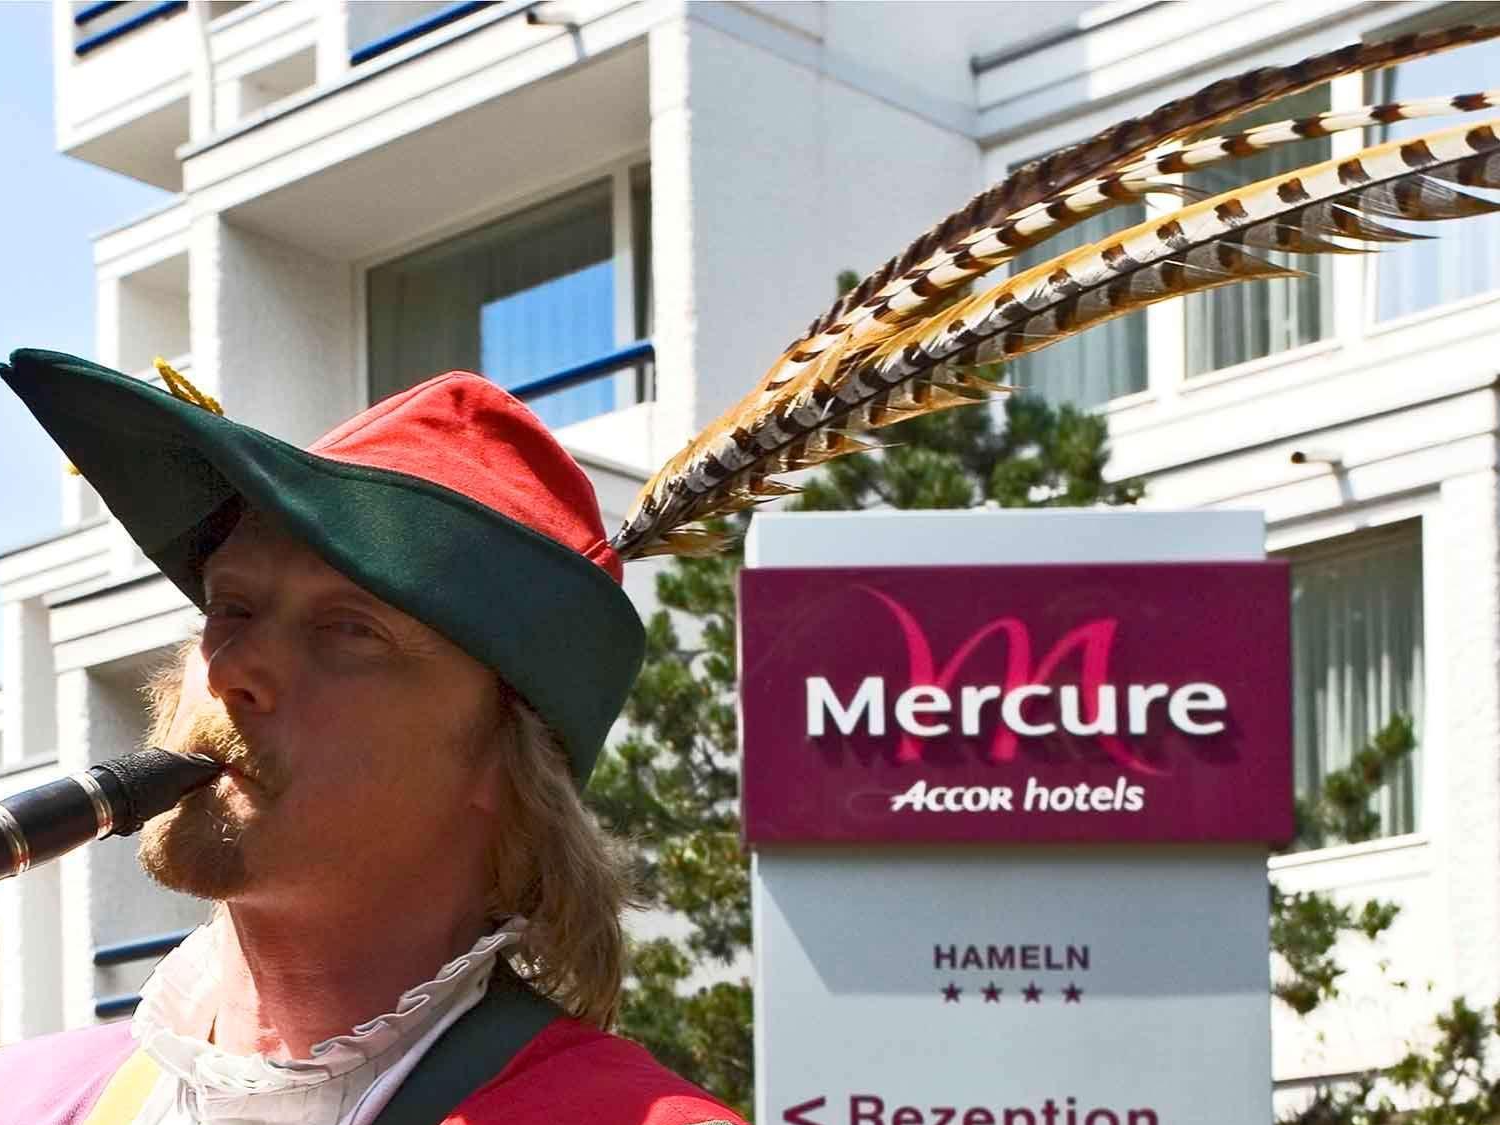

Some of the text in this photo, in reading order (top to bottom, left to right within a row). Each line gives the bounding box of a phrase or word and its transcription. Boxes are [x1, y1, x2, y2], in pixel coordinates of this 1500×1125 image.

[805, 676, 1228, 737] Mercure
[1023, 776, 1145, 812] hotels
[933, 944, 1091, 971] HAMELN
